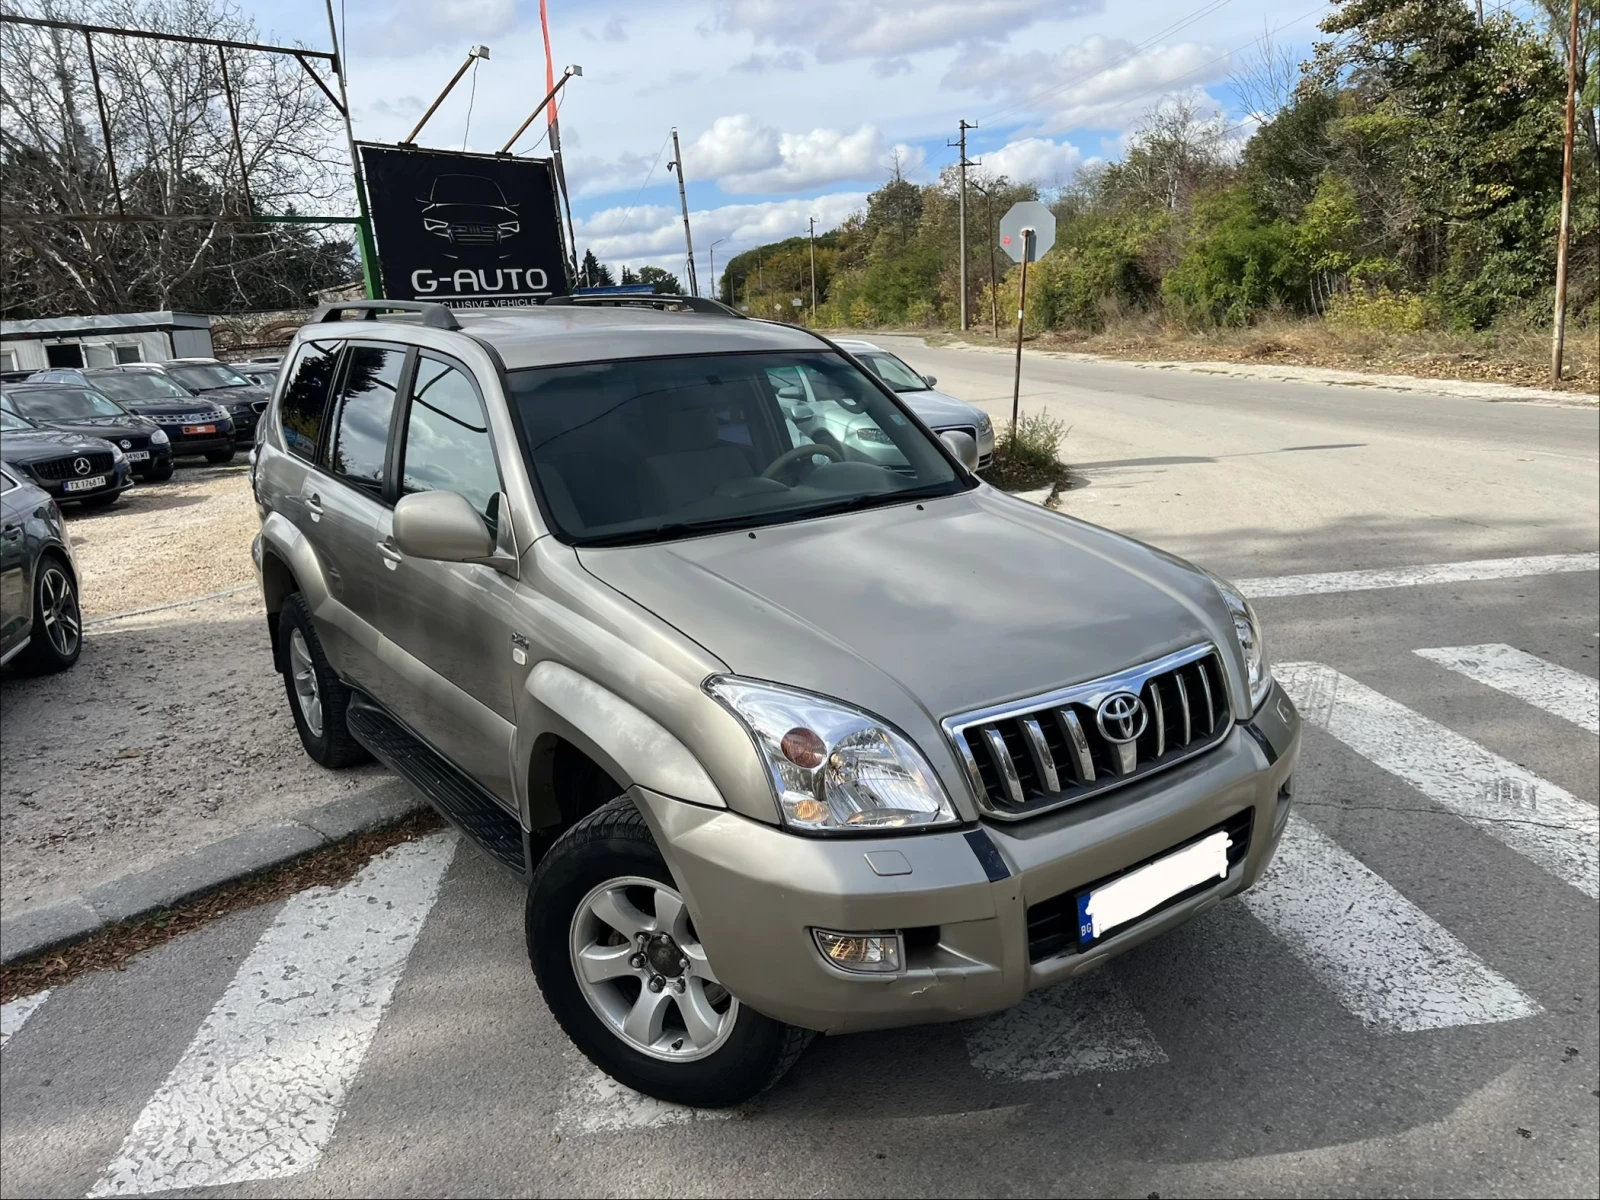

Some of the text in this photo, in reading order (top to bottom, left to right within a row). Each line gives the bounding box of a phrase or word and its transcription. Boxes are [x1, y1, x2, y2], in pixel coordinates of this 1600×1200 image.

[411, 268, 548, 292] G-AUTO
[438, 298, 538, 309] CLUSIVE VEHICLE
[70, 481, 80, 489] TX
[1081, 922, 1092, 936] BG
